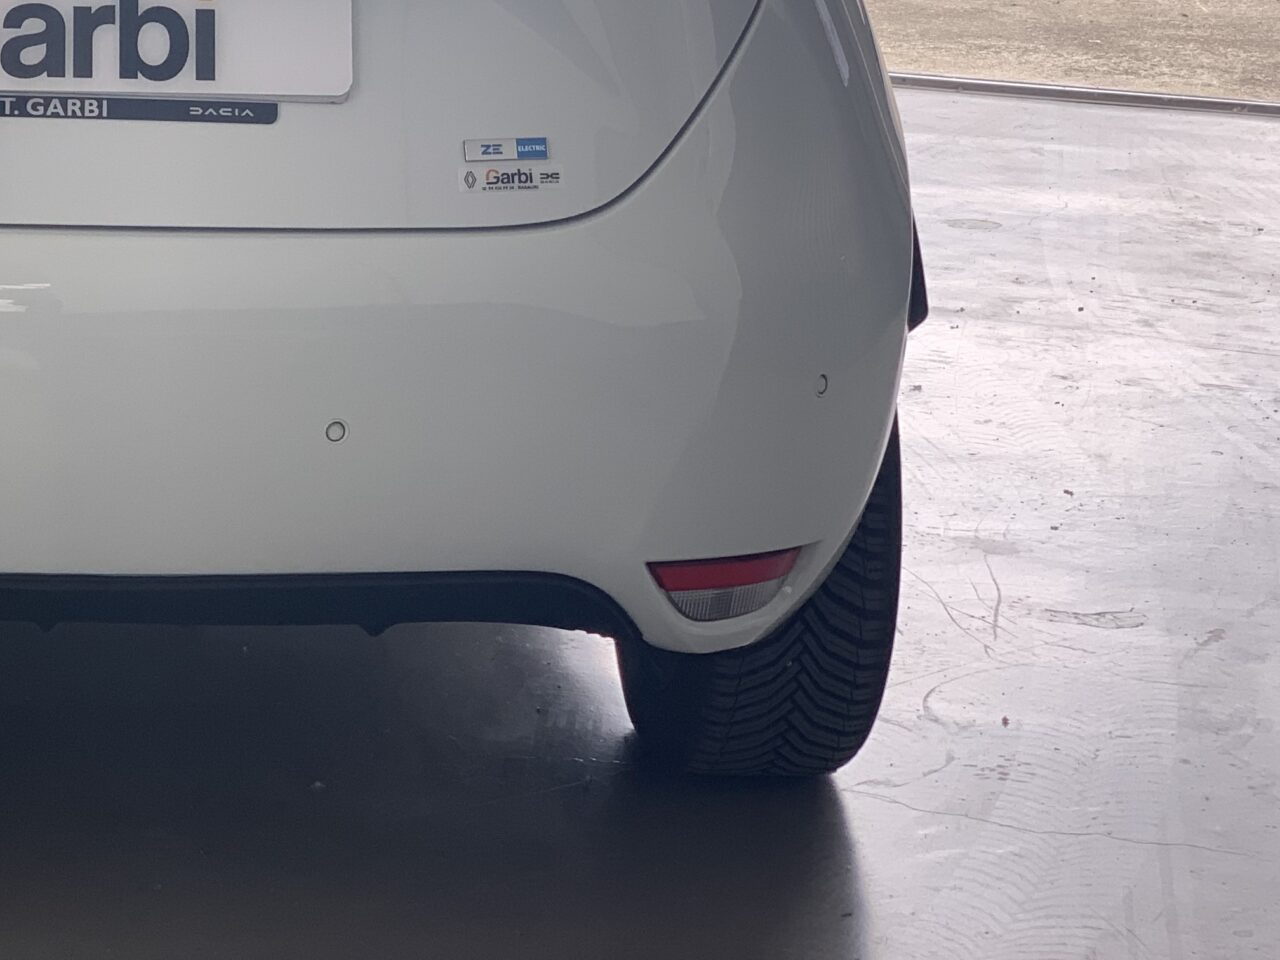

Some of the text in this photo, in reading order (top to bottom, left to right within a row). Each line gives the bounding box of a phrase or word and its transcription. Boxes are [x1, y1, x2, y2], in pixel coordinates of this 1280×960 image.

[0, 97, 108, 118] T. GARBI
[189, 106, 255, 117] DACIA
[517, 144, 547, 152] ELECTRIC
[485, 168, 534, 185] Garbi
